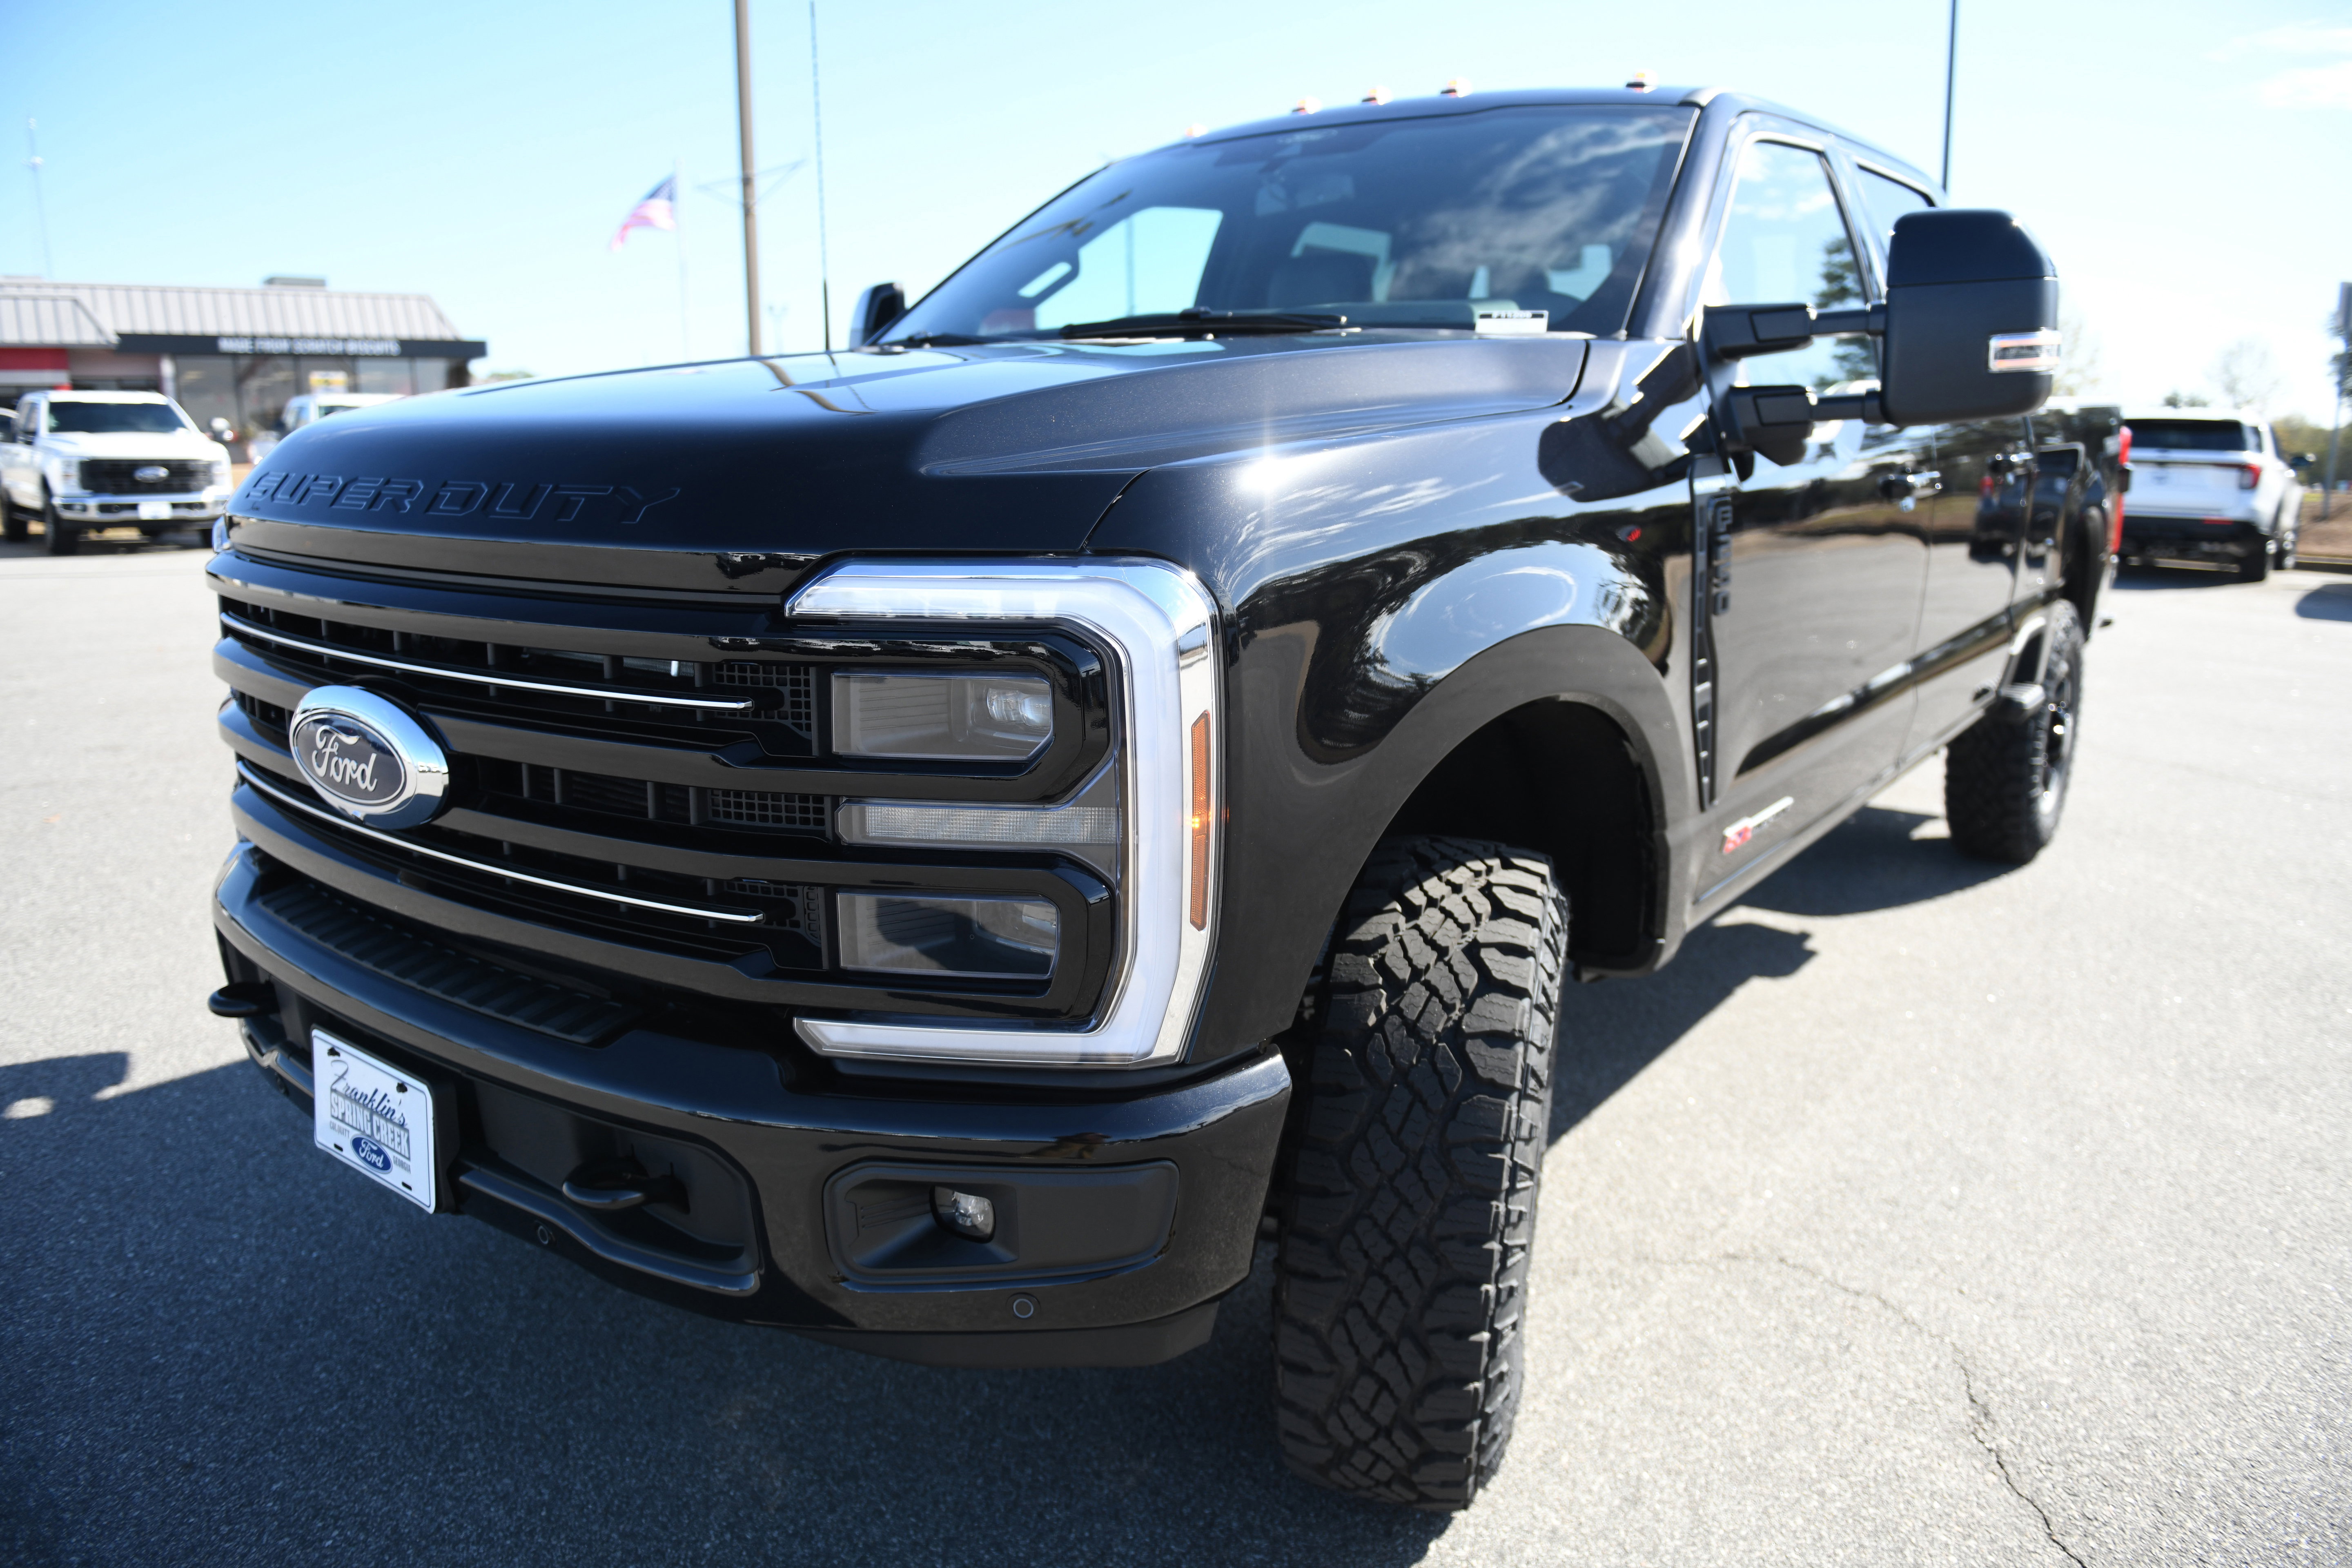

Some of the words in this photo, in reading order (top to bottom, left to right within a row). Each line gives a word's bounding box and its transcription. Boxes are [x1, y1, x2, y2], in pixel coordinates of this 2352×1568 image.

[246, 471, 424, 513] SUPER
[425, 480, 681, 524] DUTY
[312, 724, 378, 792] Ford
[330, 1060, 408, 1126] Franklin's
[330, 1120, 350, 1138] COLQUITT
[331, 1092, 371, 1137] SPRING
[373, 1115, 409, 1158] CREEK
[359, 1138, 384, 1168] Ford
[392, 1155, 411, 1174] GEORGIA
